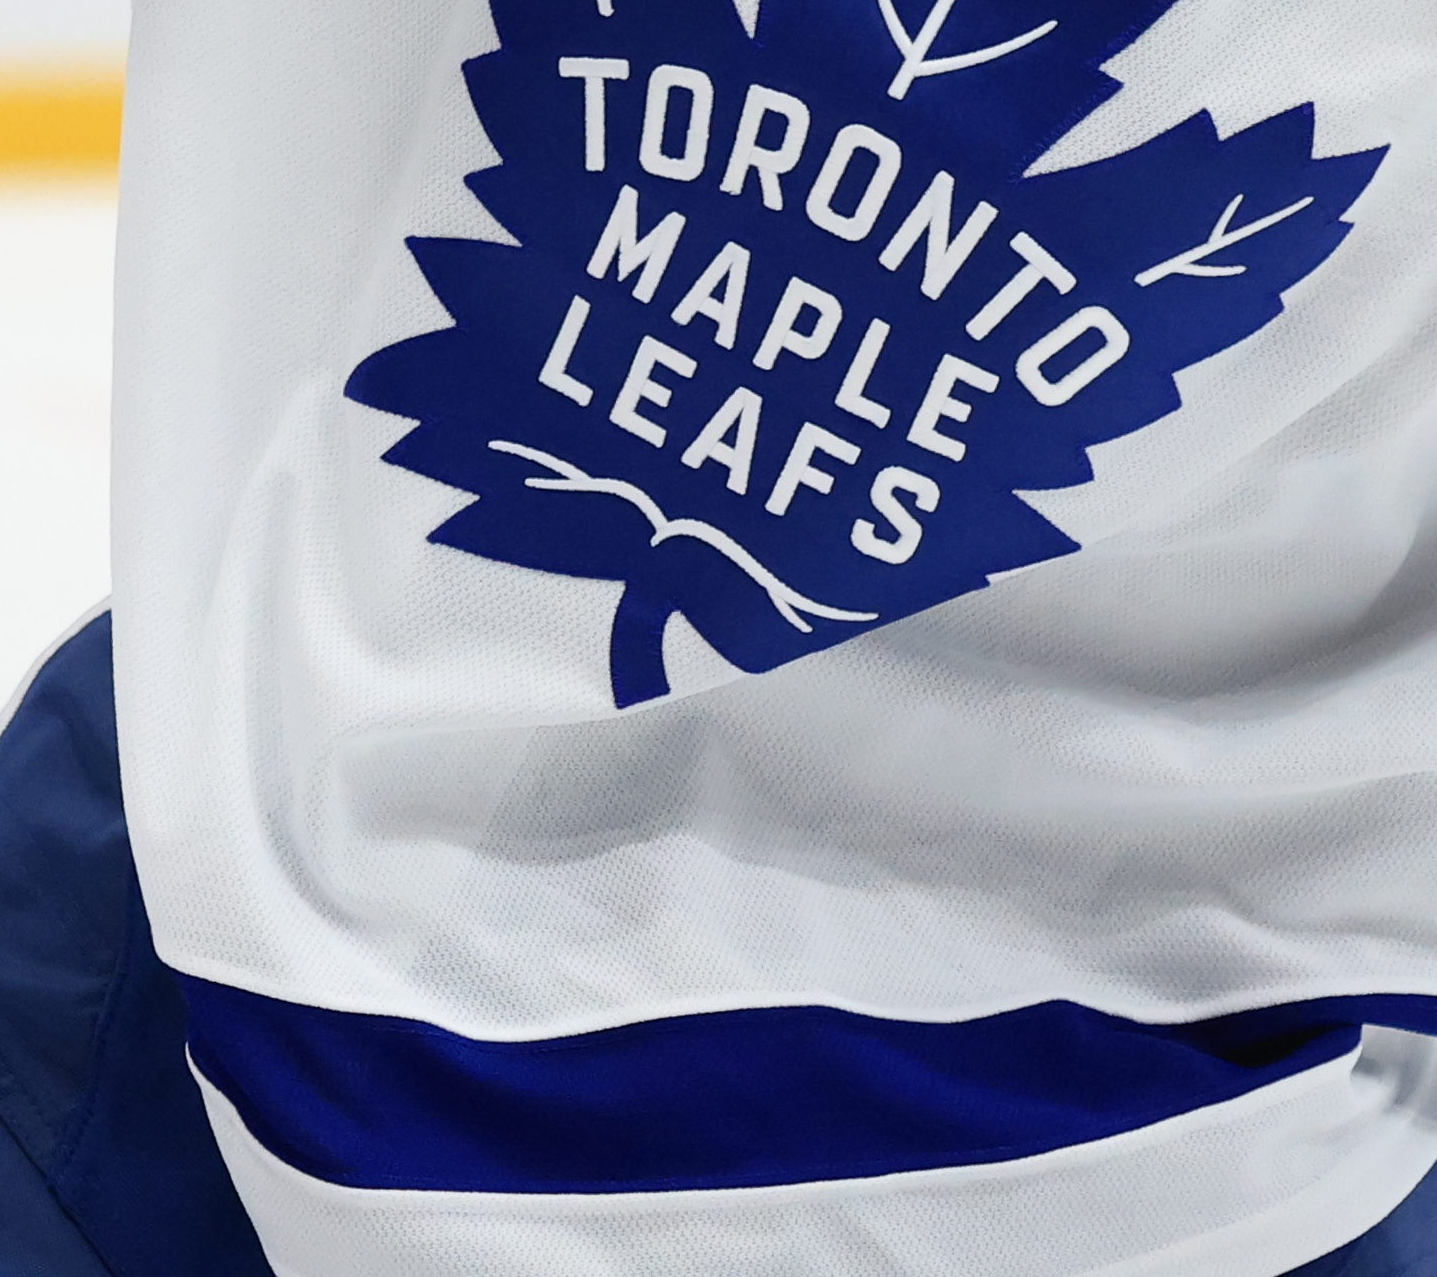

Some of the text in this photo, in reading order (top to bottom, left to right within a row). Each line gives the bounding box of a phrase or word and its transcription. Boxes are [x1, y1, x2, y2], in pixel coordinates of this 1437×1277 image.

[558, 56, 1130, 408] TORONTO
[586, 184, 1001, 462] MAPLE
[538, 294, 941, 565] LEAFS
